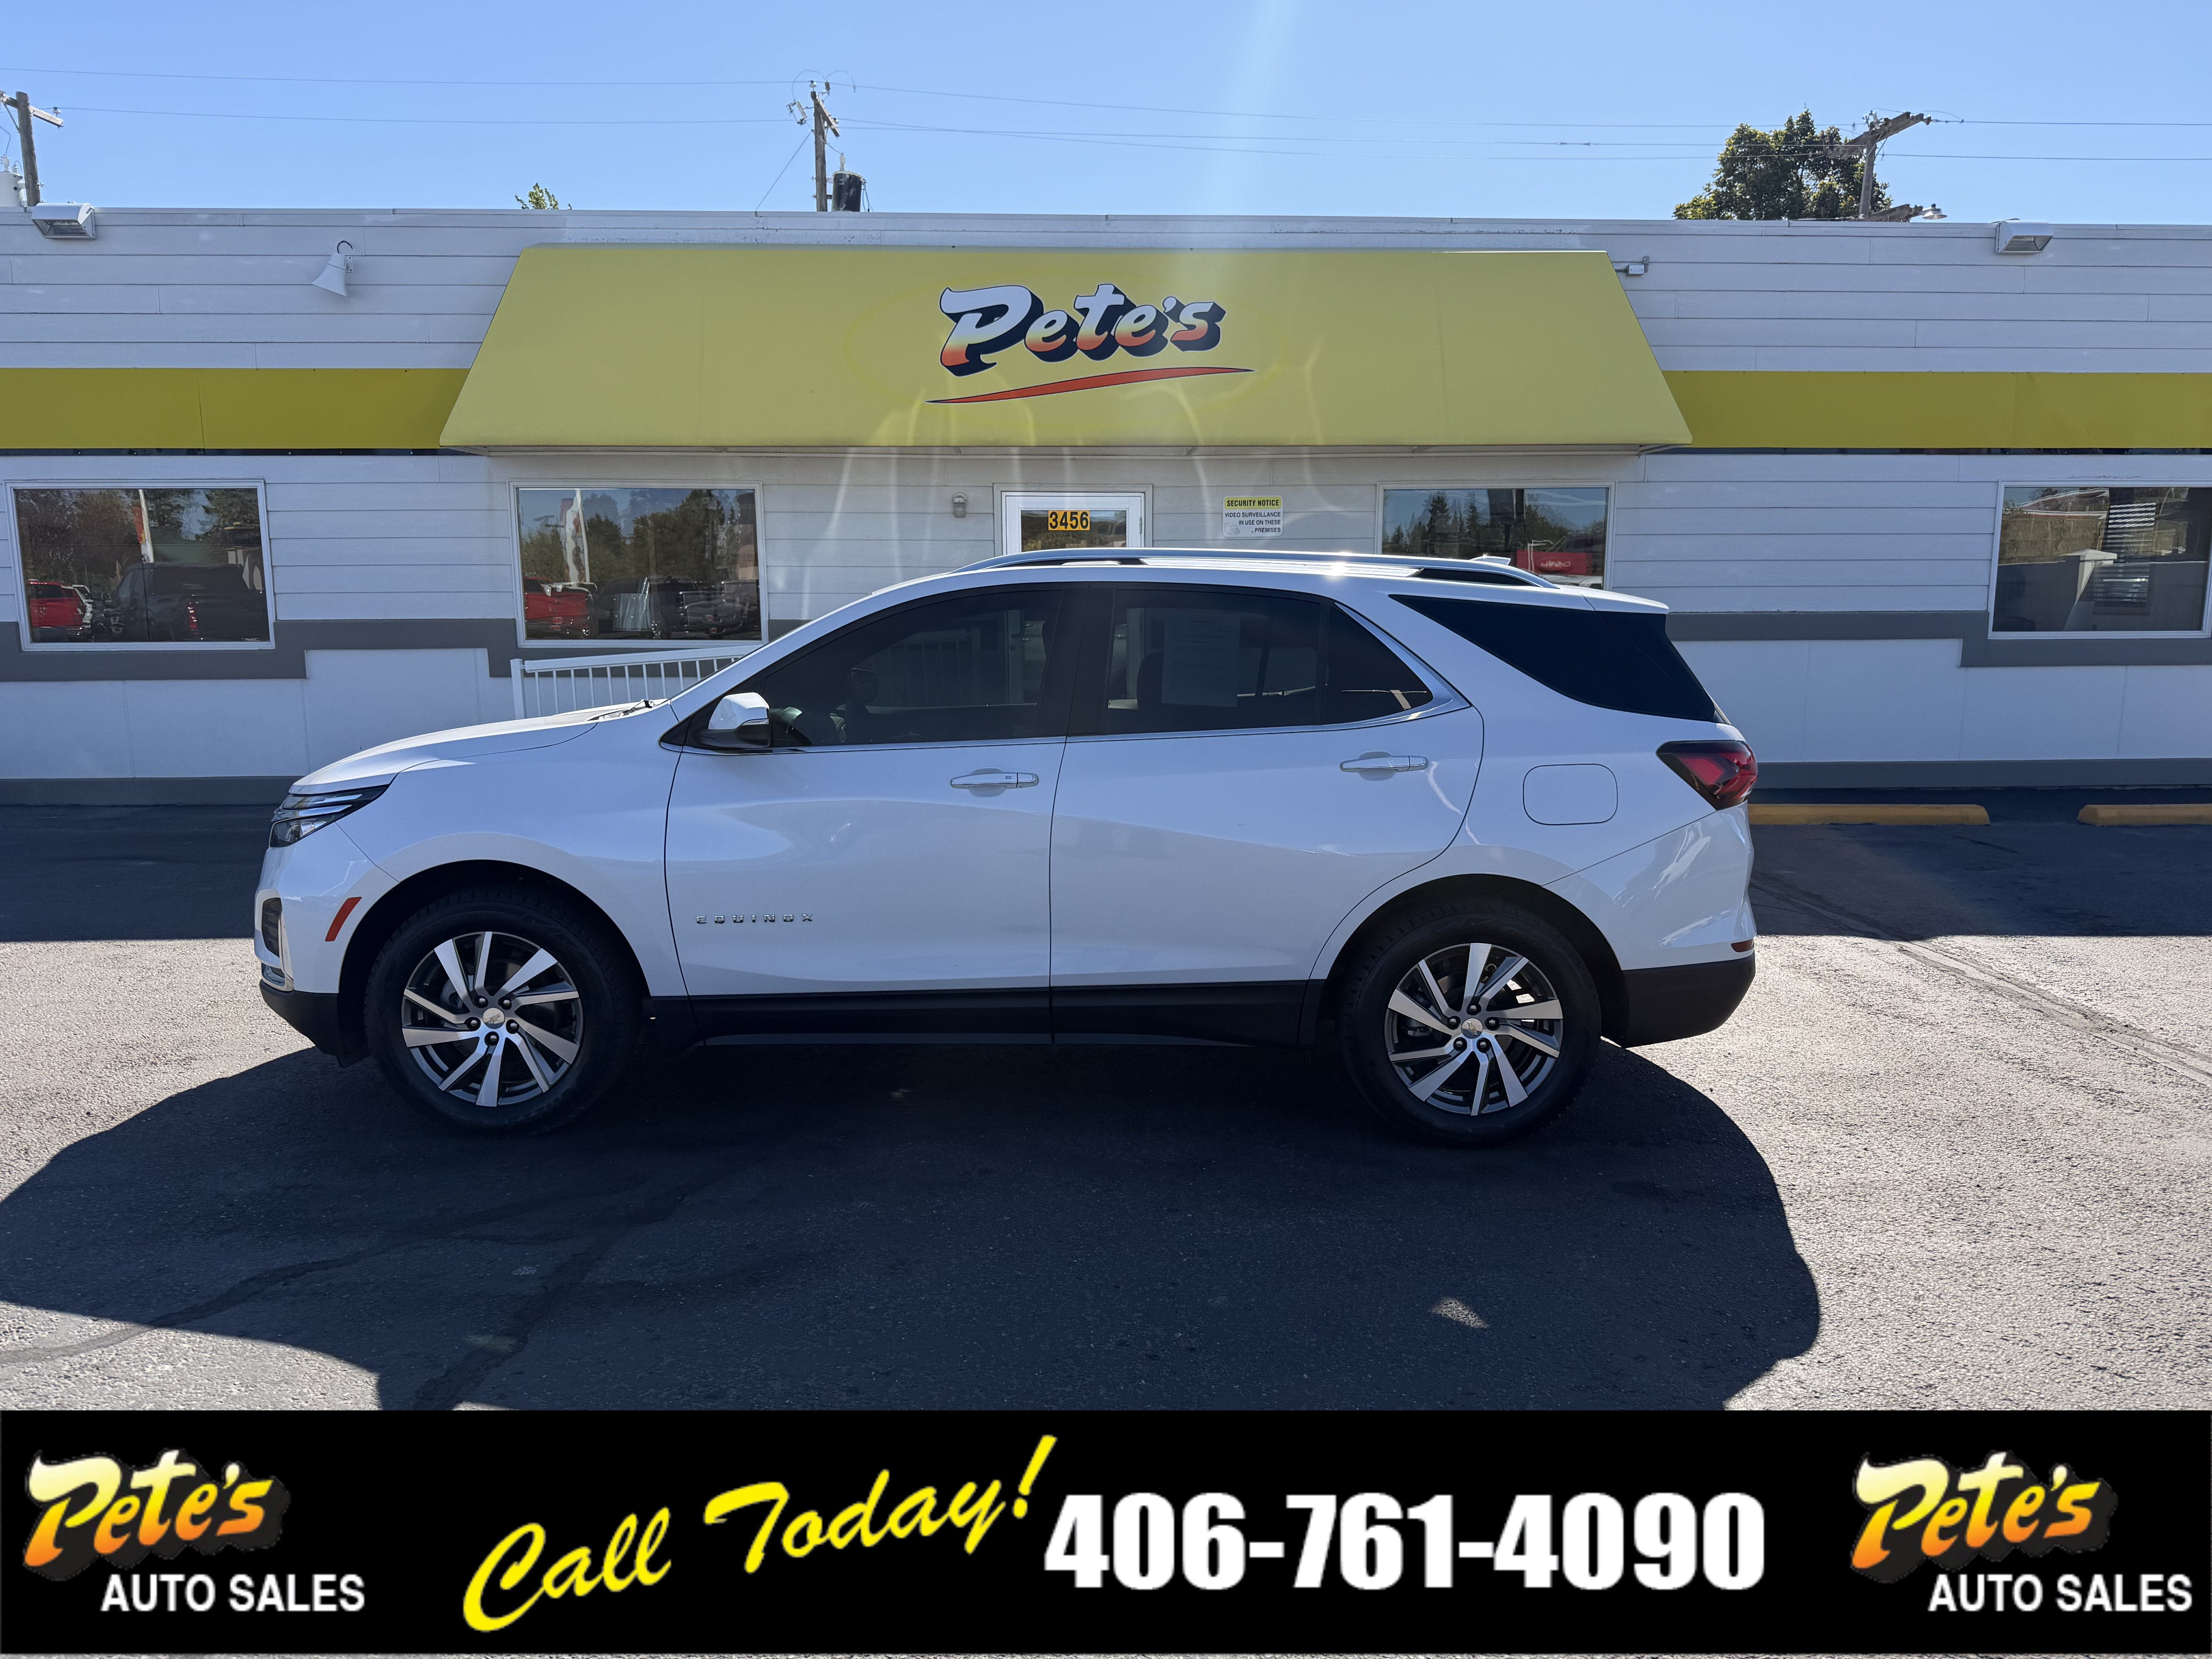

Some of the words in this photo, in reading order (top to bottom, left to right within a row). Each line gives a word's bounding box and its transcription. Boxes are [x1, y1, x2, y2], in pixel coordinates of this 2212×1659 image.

[939, 283, 1226, 377] Pete's
[1049, 511, 1089, 529] 3456
[696, 913, 812, 924] EQUINOX
